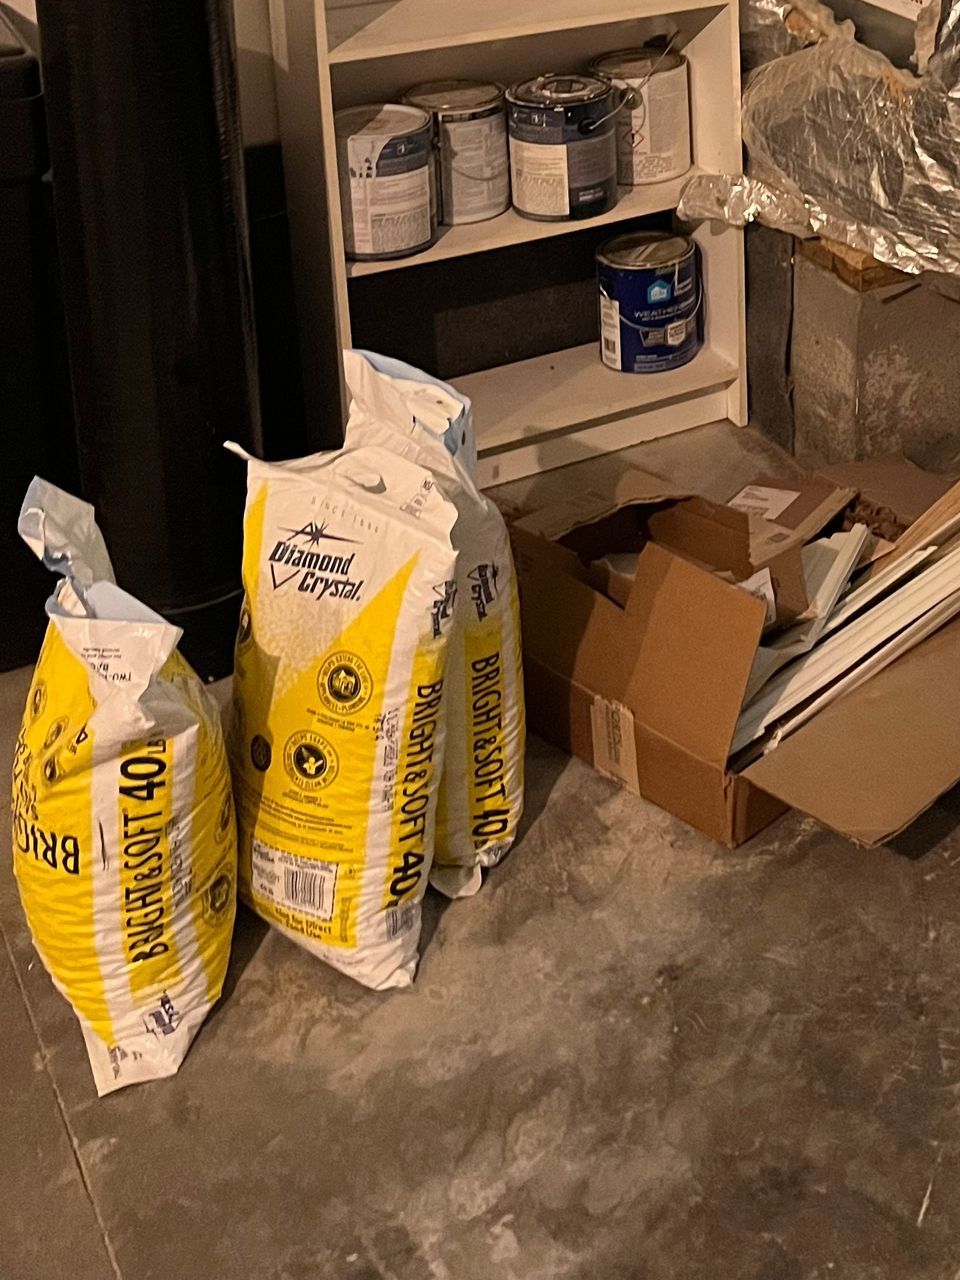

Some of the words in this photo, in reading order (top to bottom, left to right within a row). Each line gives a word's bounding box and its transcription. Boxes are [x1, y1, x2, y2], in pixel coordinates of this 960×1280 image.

[268, 540, 356, 576] Diamond
[119, 756, 167, 802] 40
[389, 851, 425, 894] 40
